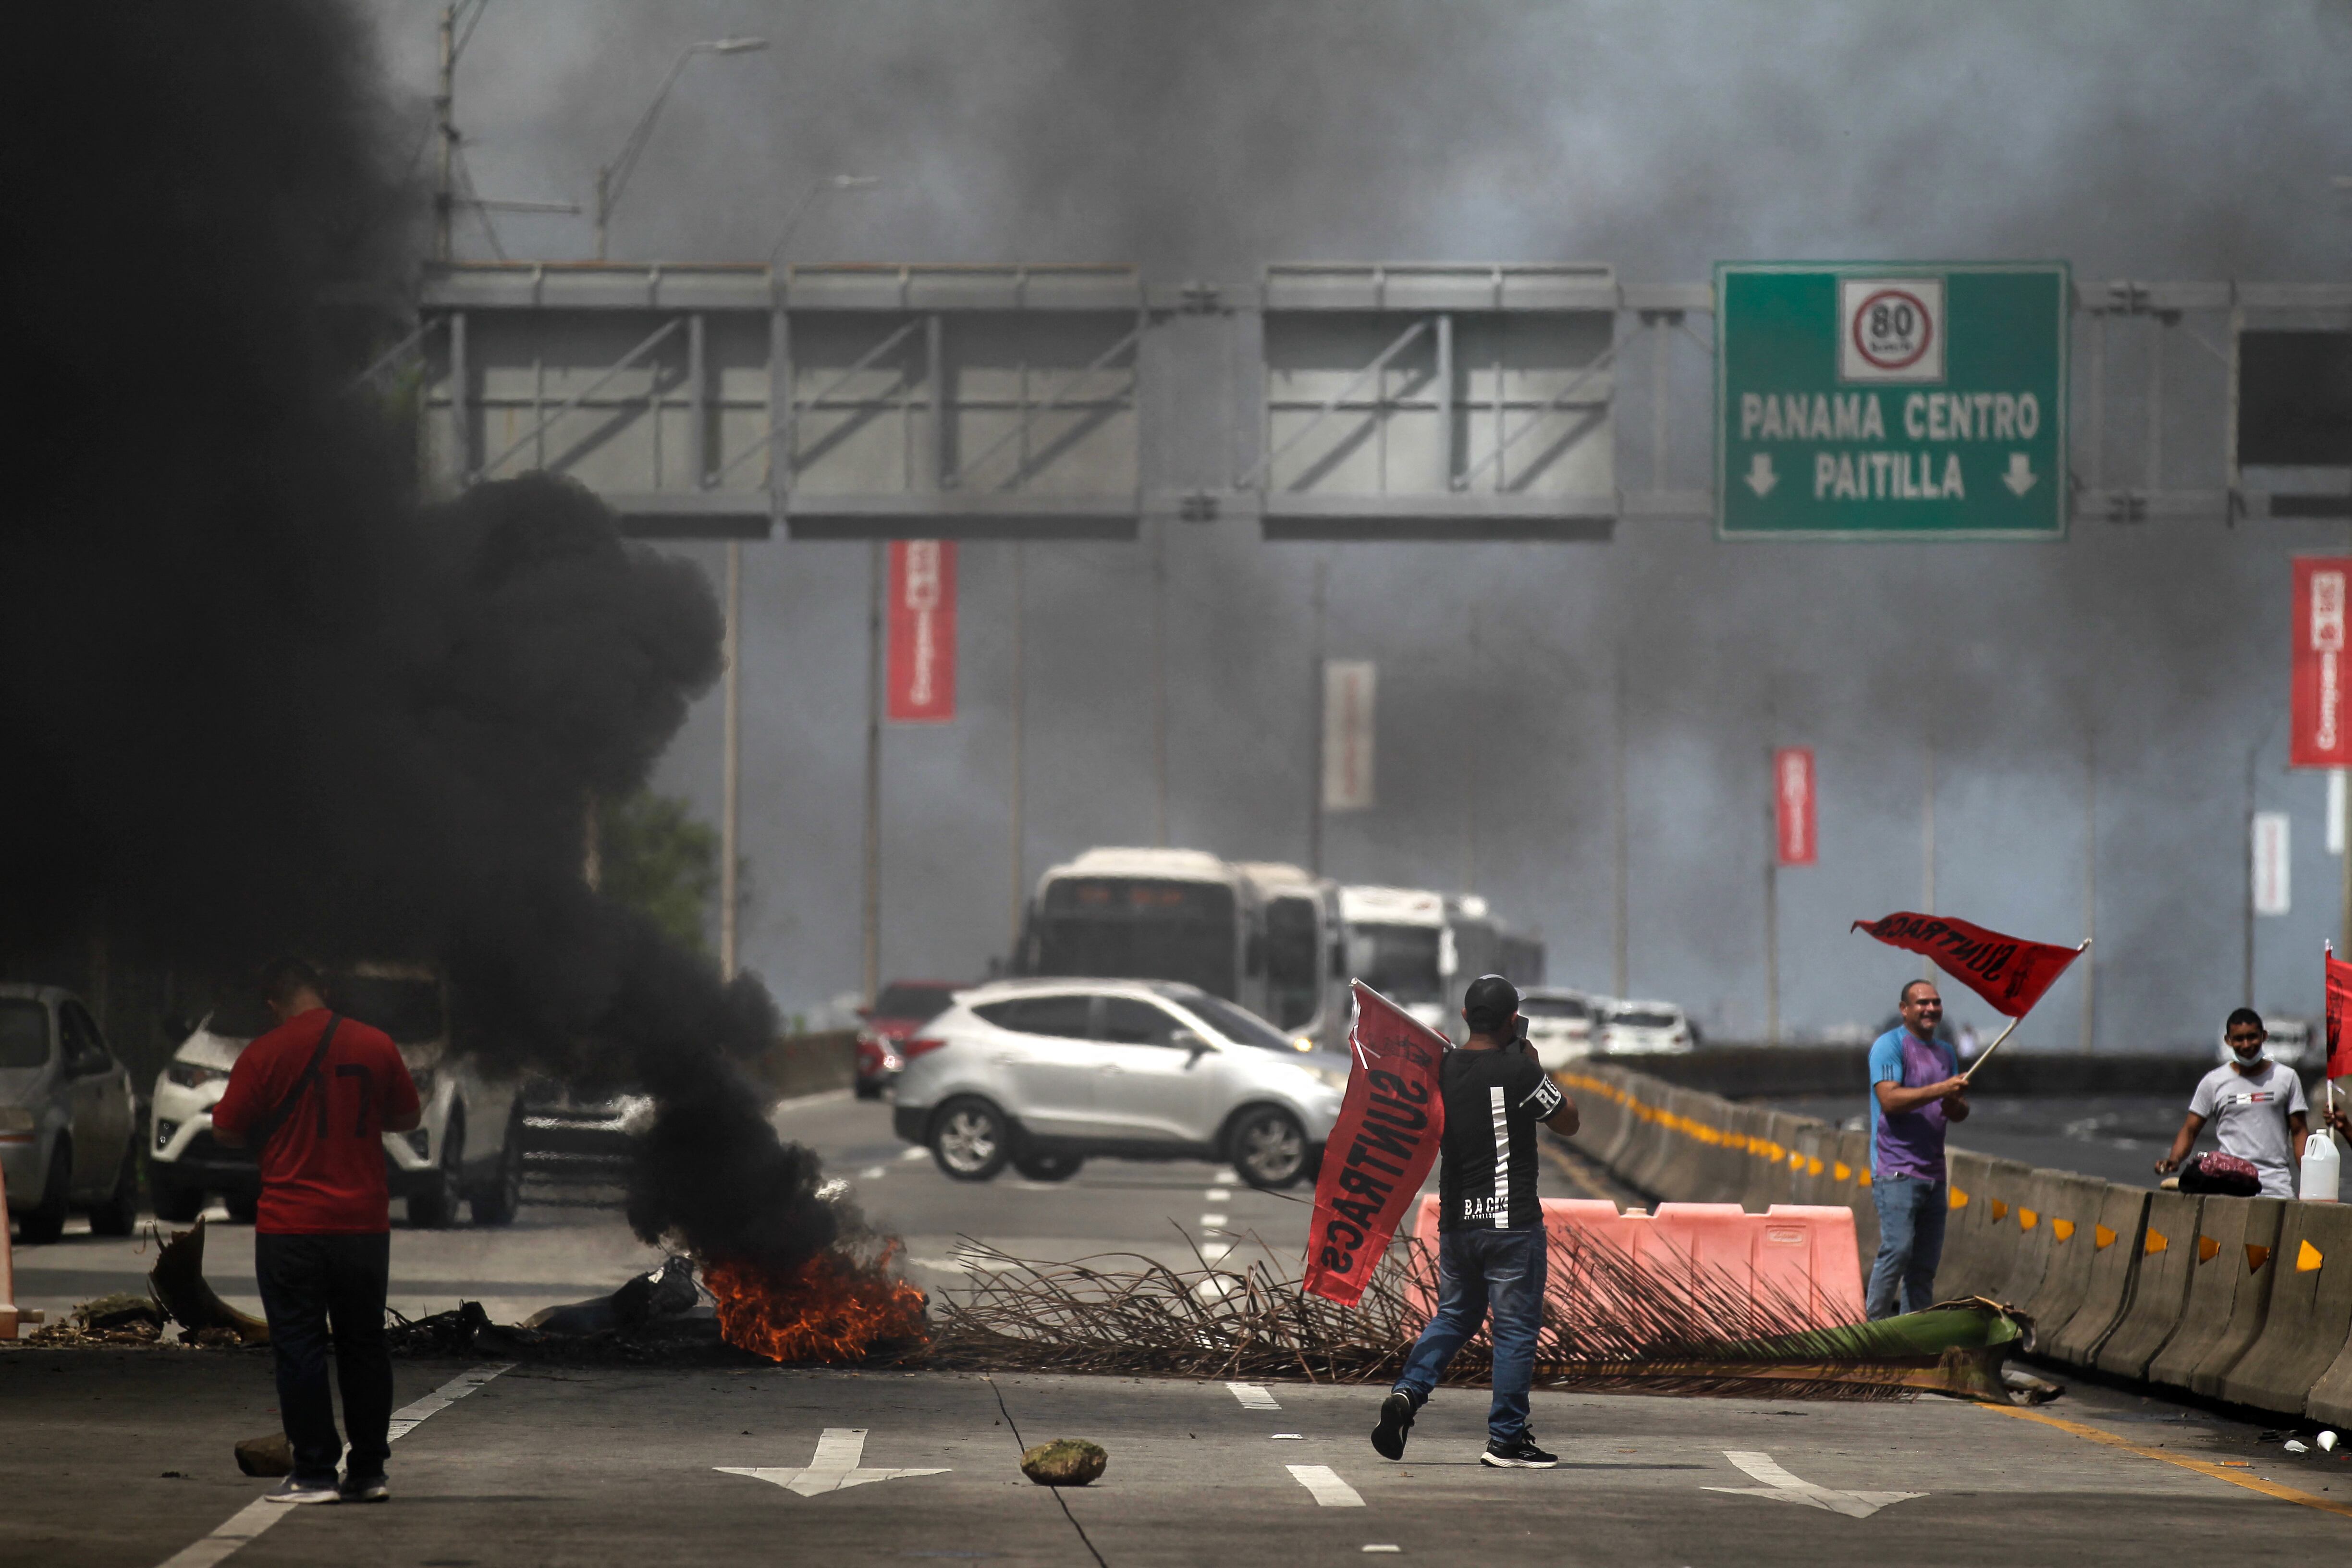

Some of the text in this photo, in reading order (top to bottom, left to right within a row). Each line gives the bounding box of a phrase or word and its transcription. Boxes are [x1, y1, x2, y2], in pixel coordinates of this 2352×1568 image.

[1872, 305, 1913, 337] 80
[1741, 392, 2039, 439] PANAMA CENTRO
[1815, 452, 1964, 500] PAITILLA
[1465, 1197, 1507, 1215] BACK
